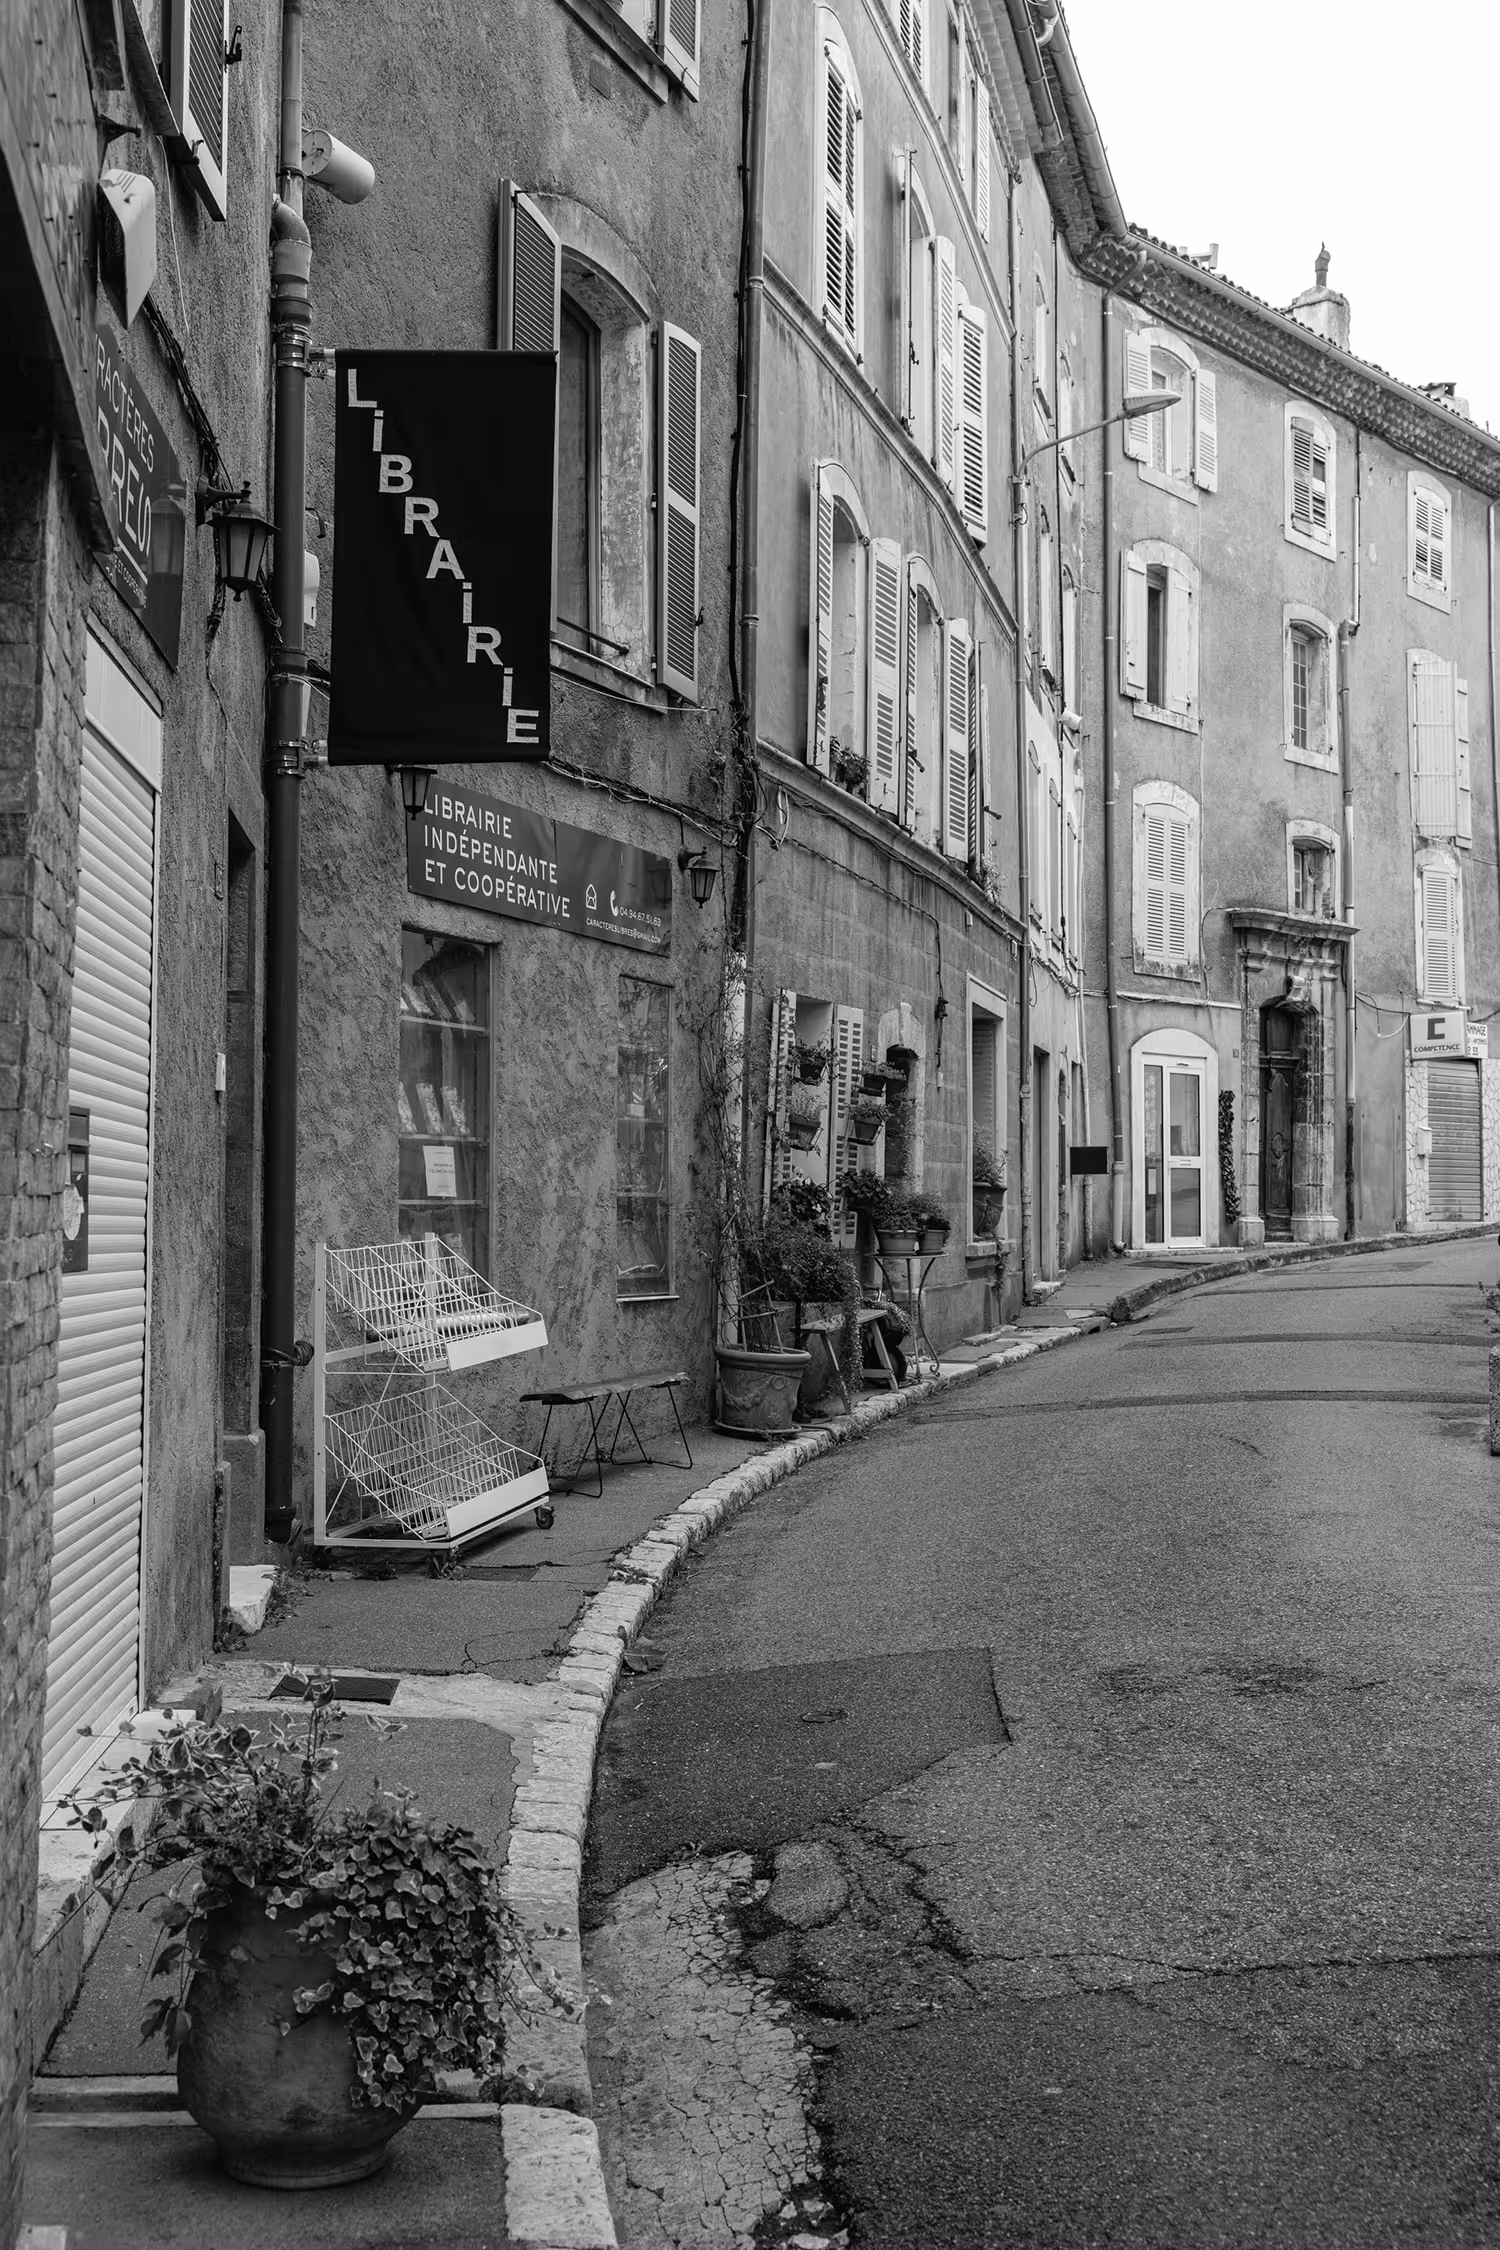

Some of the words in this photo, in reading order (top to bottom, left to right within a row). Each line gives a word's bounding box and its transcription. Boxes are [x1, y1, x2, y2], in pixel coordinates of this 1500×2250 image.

[95, 333, 154, 473] RACTÈRES
[424, 793, 512, 838] LIBRAIRIE
[424, 824, 558, 885] INDÉPENDANTE
[425, 858, 447, 885] ET
[454, 867, 571, 918] COOPÉRATIVE
[619, 906, 661, 927] 04.94.67.51.63
[1413, 1044, 1461, 1053] COMPETENCE
